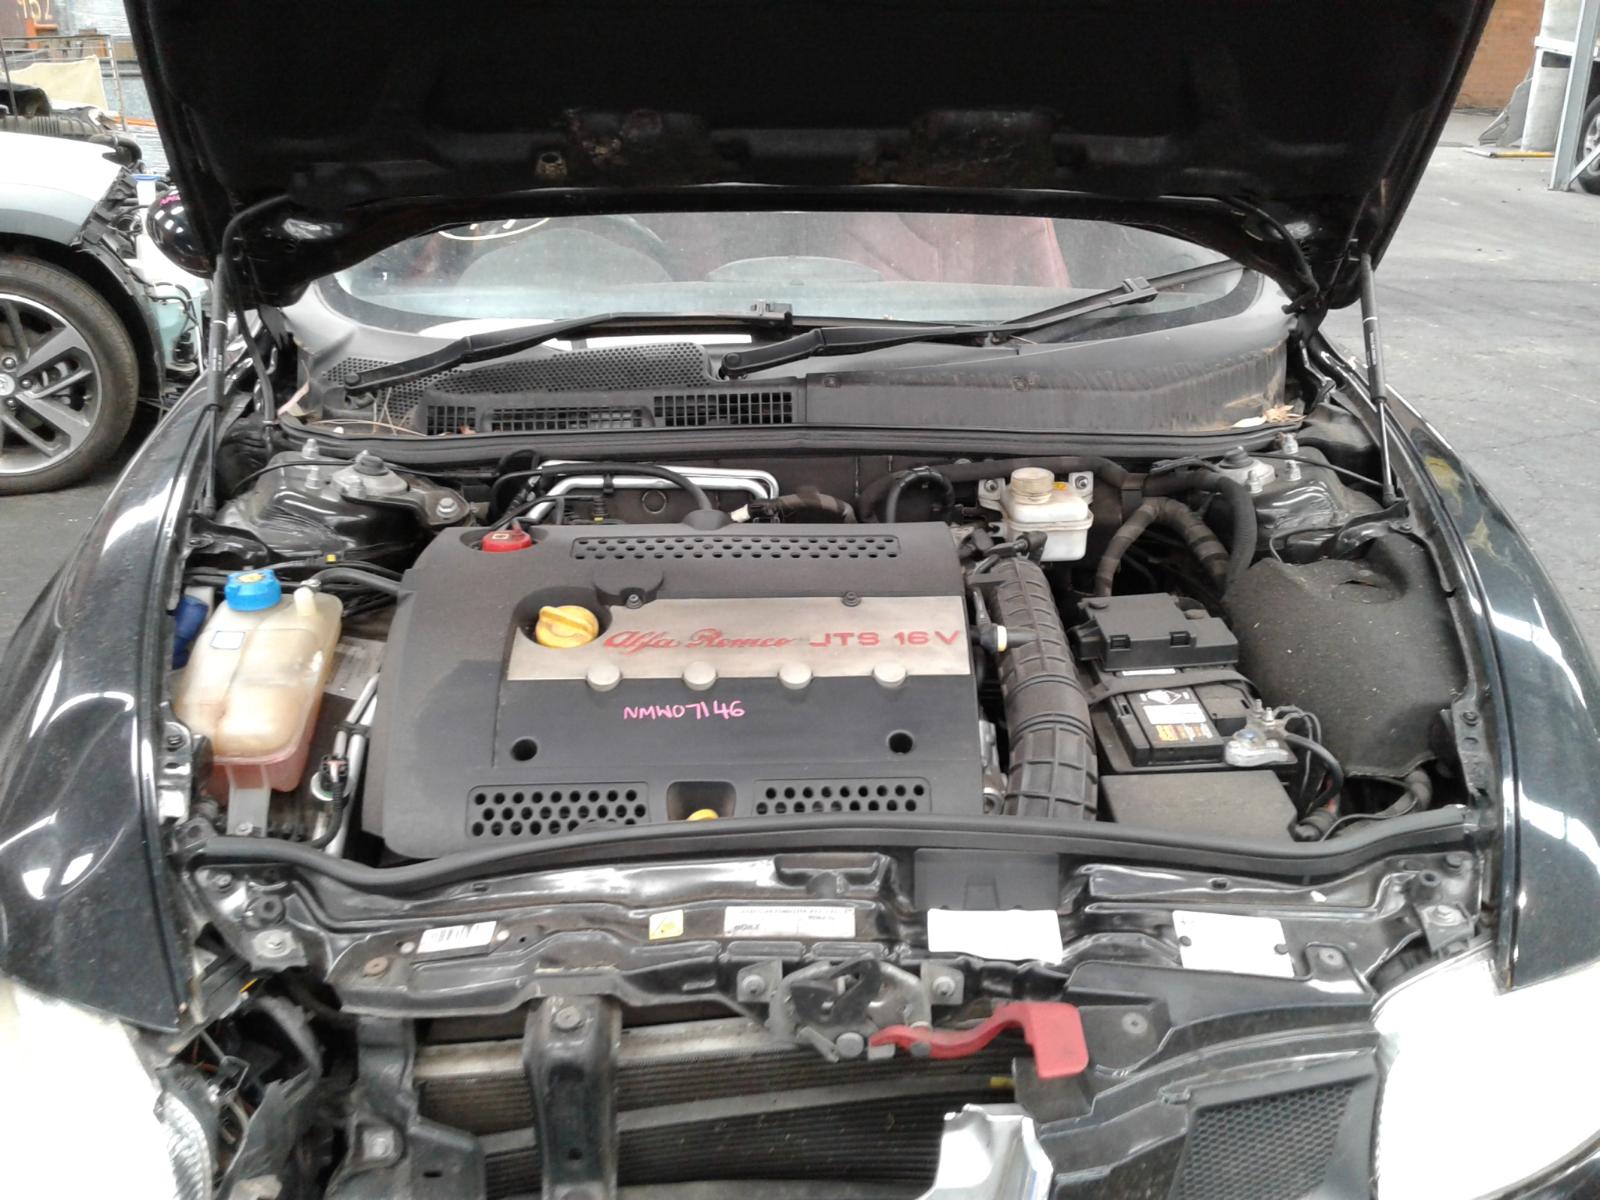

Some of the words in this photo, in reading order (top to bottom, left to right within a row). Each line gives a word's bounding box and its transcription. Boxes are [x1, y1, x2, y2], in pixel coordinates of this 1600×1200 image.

[603, 630, 681, 657] Alfa
[685, 627, 796, 649] Romeo
[809, 631, 882, 648] JTS
[893, 630, 961, 646] 16V
